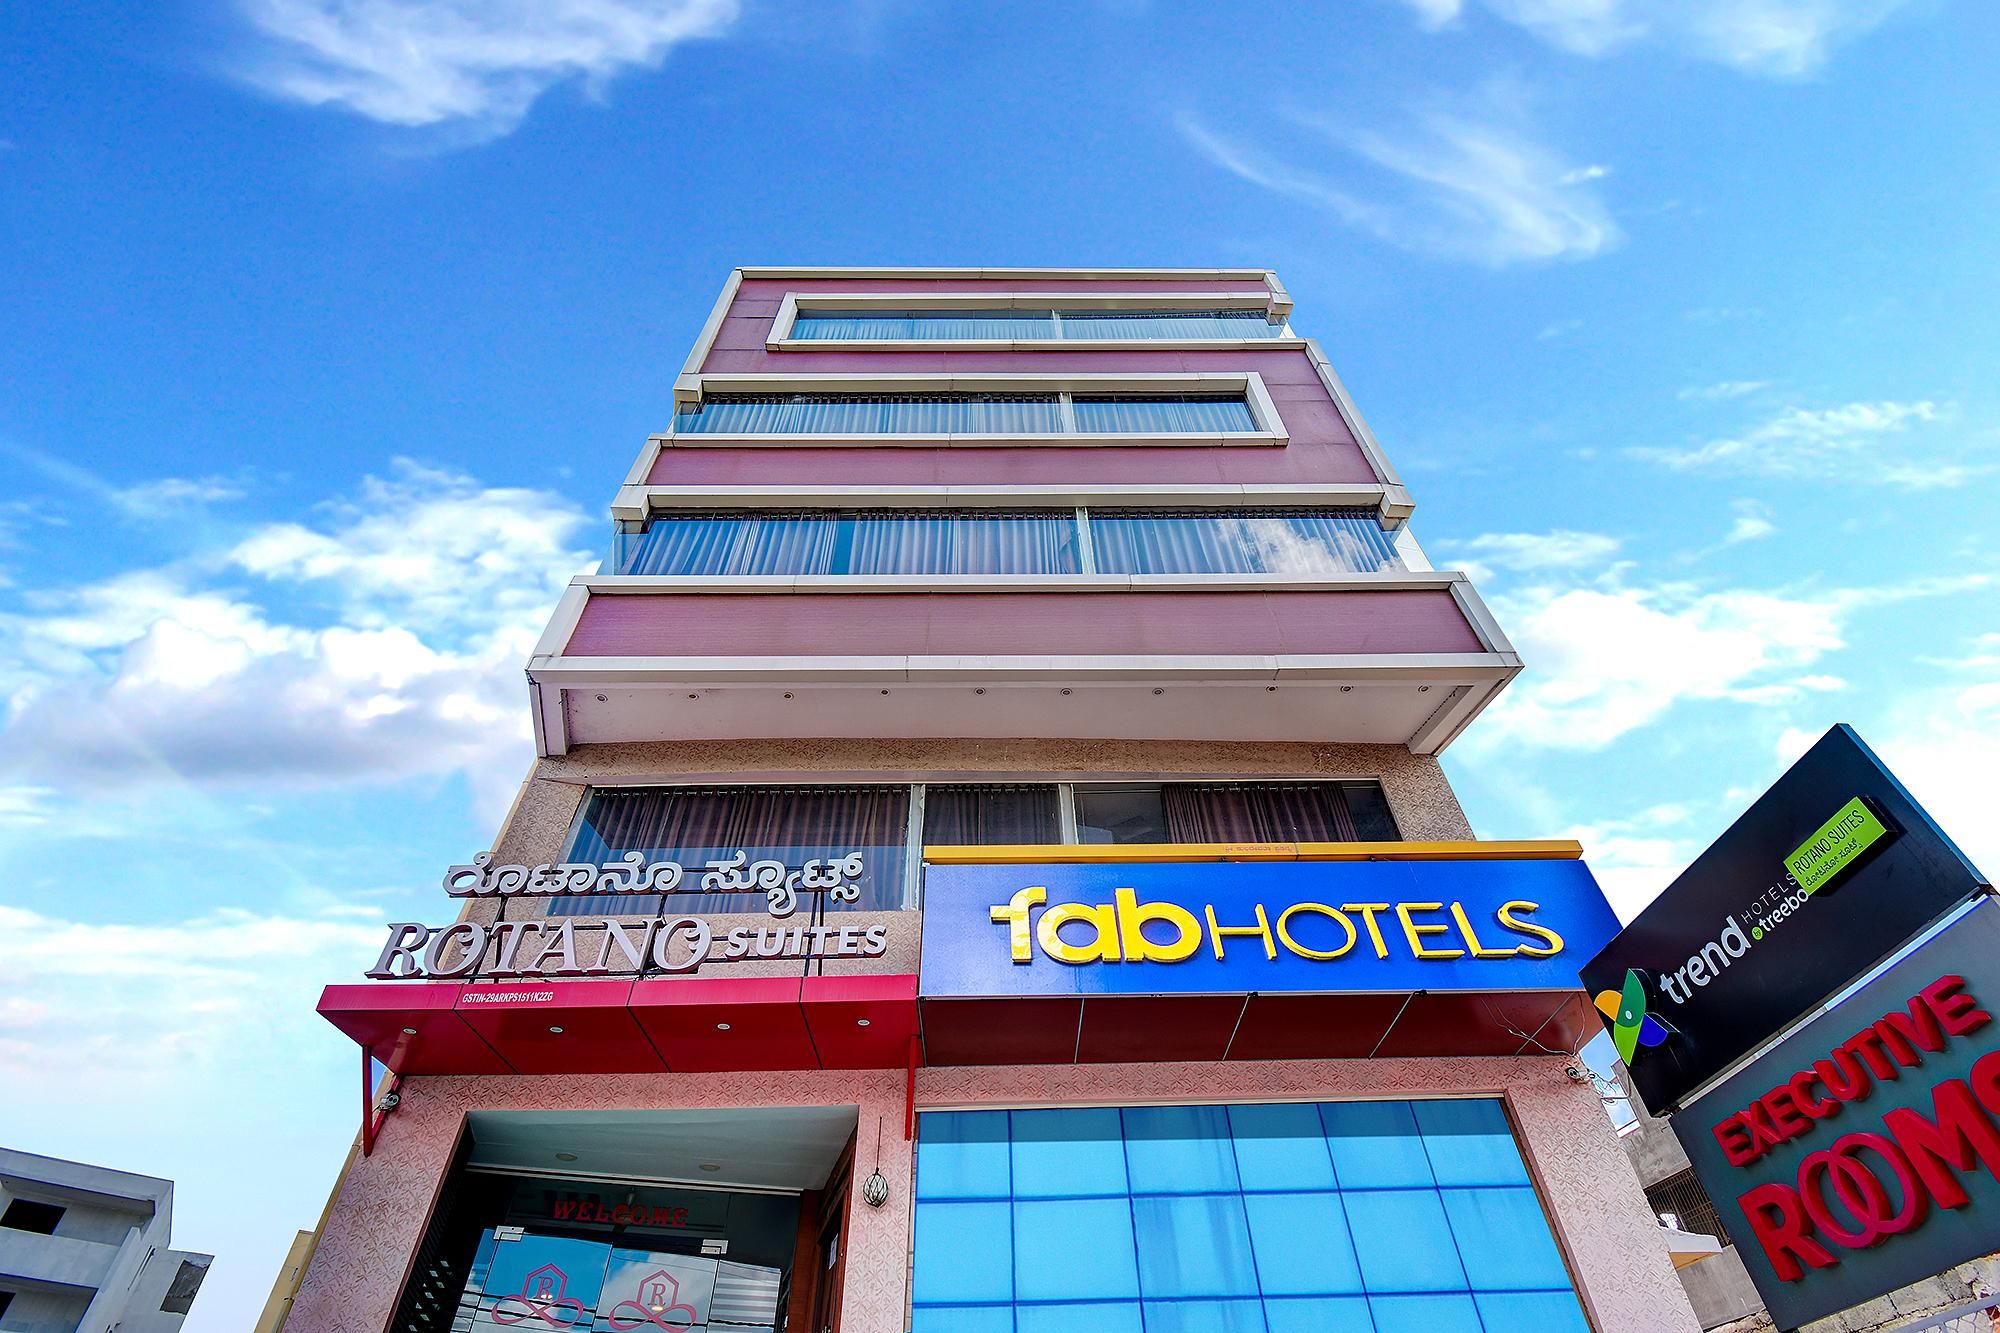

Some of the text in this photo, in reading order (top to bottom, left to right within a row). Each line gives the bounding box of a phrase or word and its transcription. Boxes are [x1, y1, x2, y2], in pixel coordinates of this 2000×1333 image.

[1793, 809, 1865, 875] ROTANO SUITES
[1740, 872, 1797, 925] HOTELS
[1758, 888, 1809, 932] treebo
[364, 917, 888, 980] ROTANO SUITES
[1660, 915, 1752, 1004] trend
[1711, 974, 1992, 1168] EXECUTIVE
[553, 1200, 689, 1228] WELCOME
[647, 1283, 667, 1306] R
